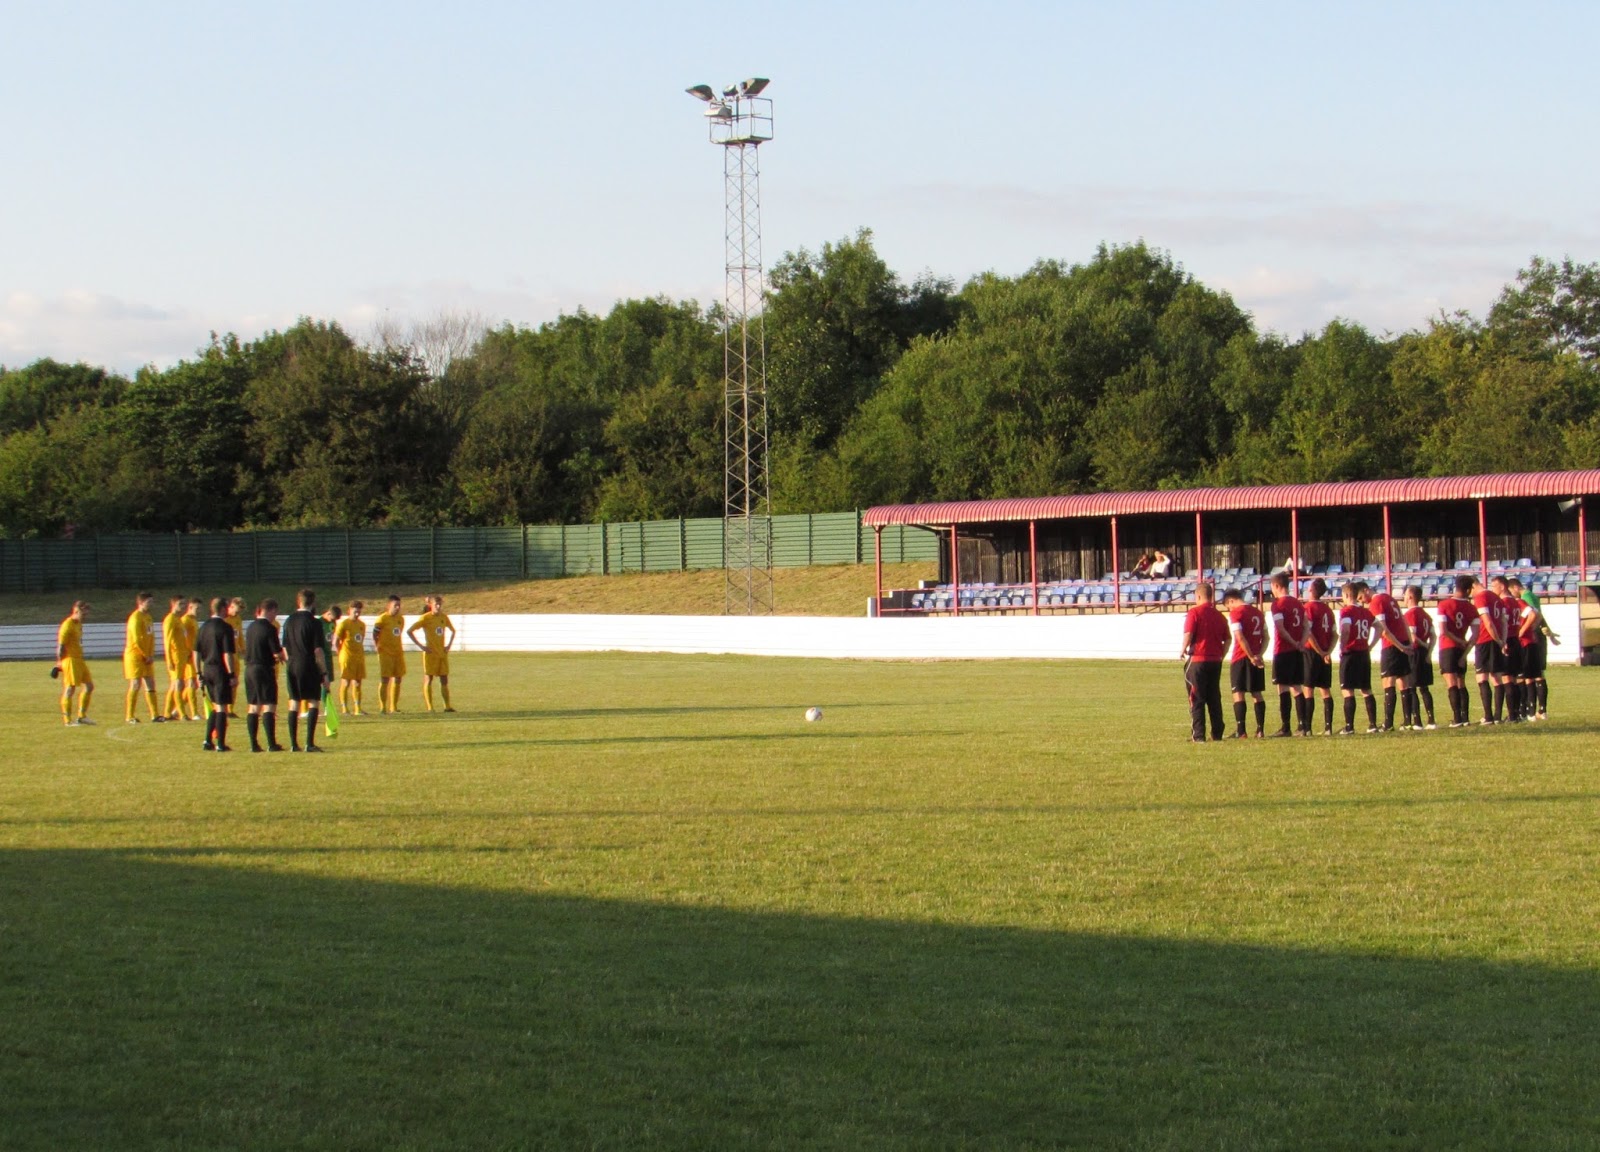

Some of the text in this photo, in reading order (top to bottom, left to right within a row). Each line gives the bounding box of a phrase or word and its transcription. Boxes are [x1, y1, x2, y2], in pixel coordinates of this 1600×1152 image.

[1292, 607, 1301, 627] 3
[1390, 601, 1400, 619] 5
[1493, 600, 1500, 619] 6
[1251, 616, 1261, 635] 2
[1321, 613, 1330, 632] 4
[1355, 619, 1369, 639] 18
[1422, 618, 1430, 637] 9
[1455, 611, 1464, 629] 8
